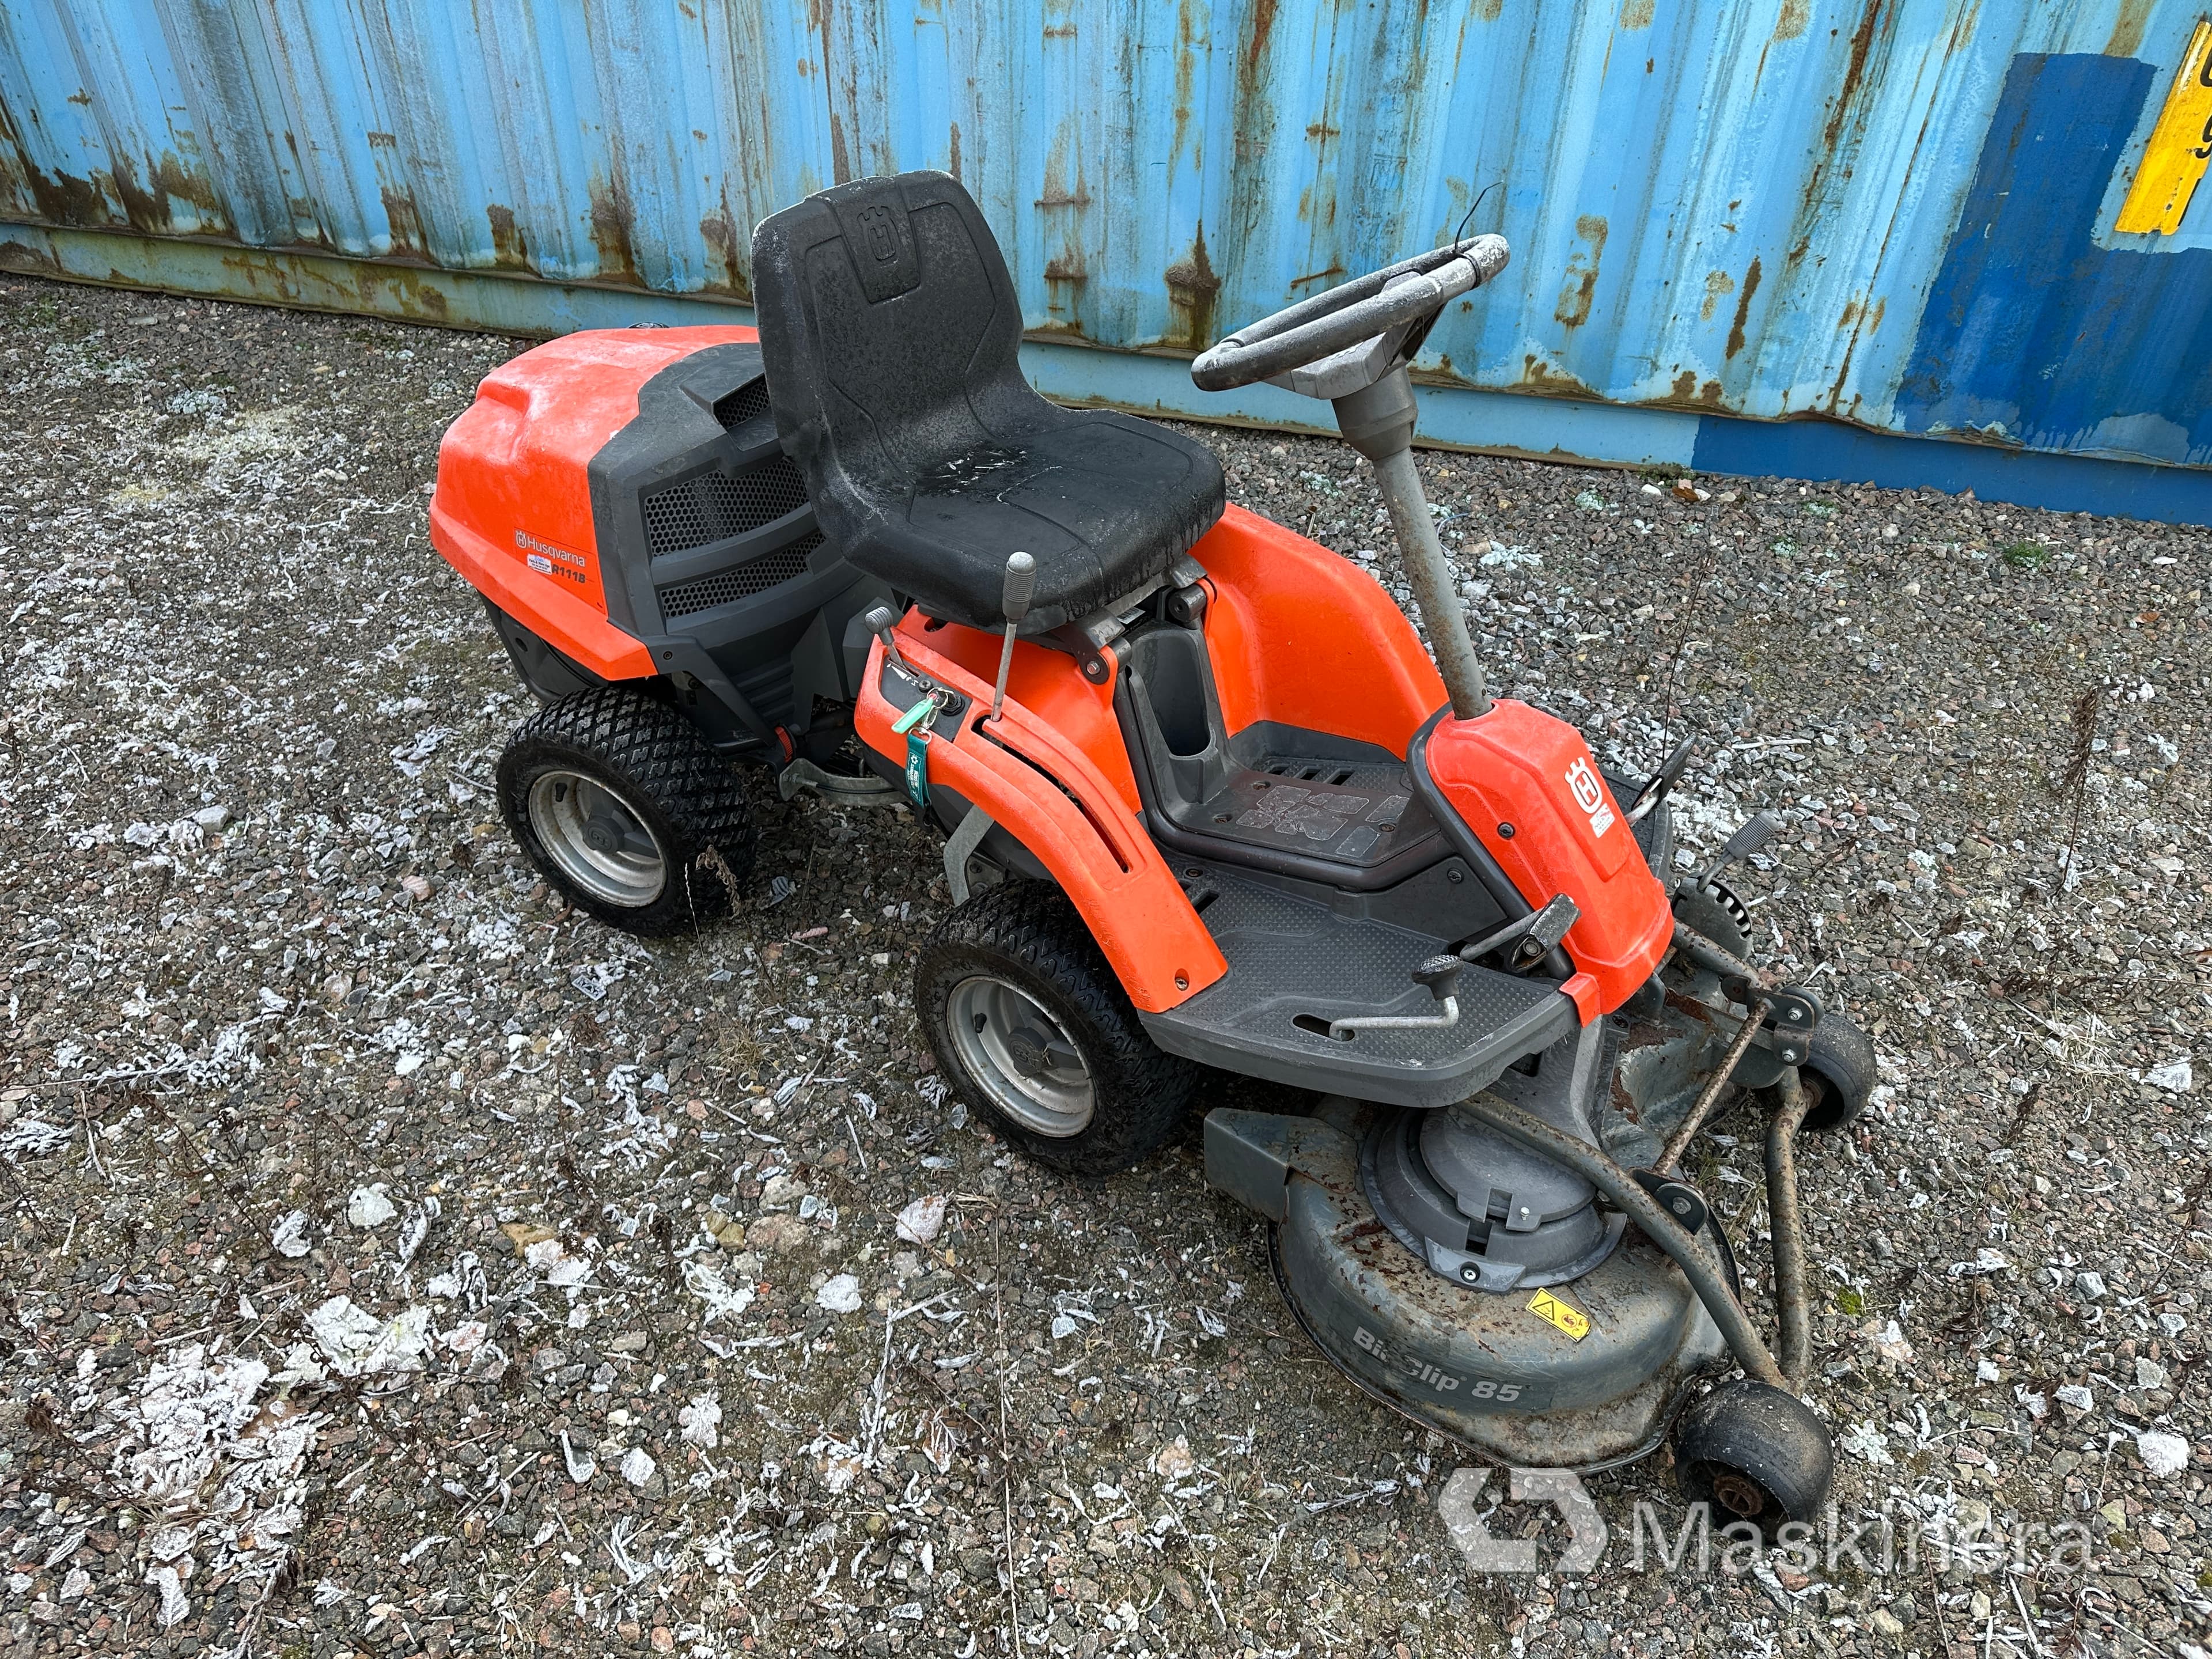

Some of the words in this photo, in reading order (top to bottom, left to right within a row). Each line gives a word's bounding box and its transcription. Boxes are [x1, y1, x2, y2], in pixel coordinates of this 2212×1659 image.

[527, 536, 585, 567] Husqvarna
[552, 564, 586, 583] R111B
[1471, 1381, 1522, 1402] 85
